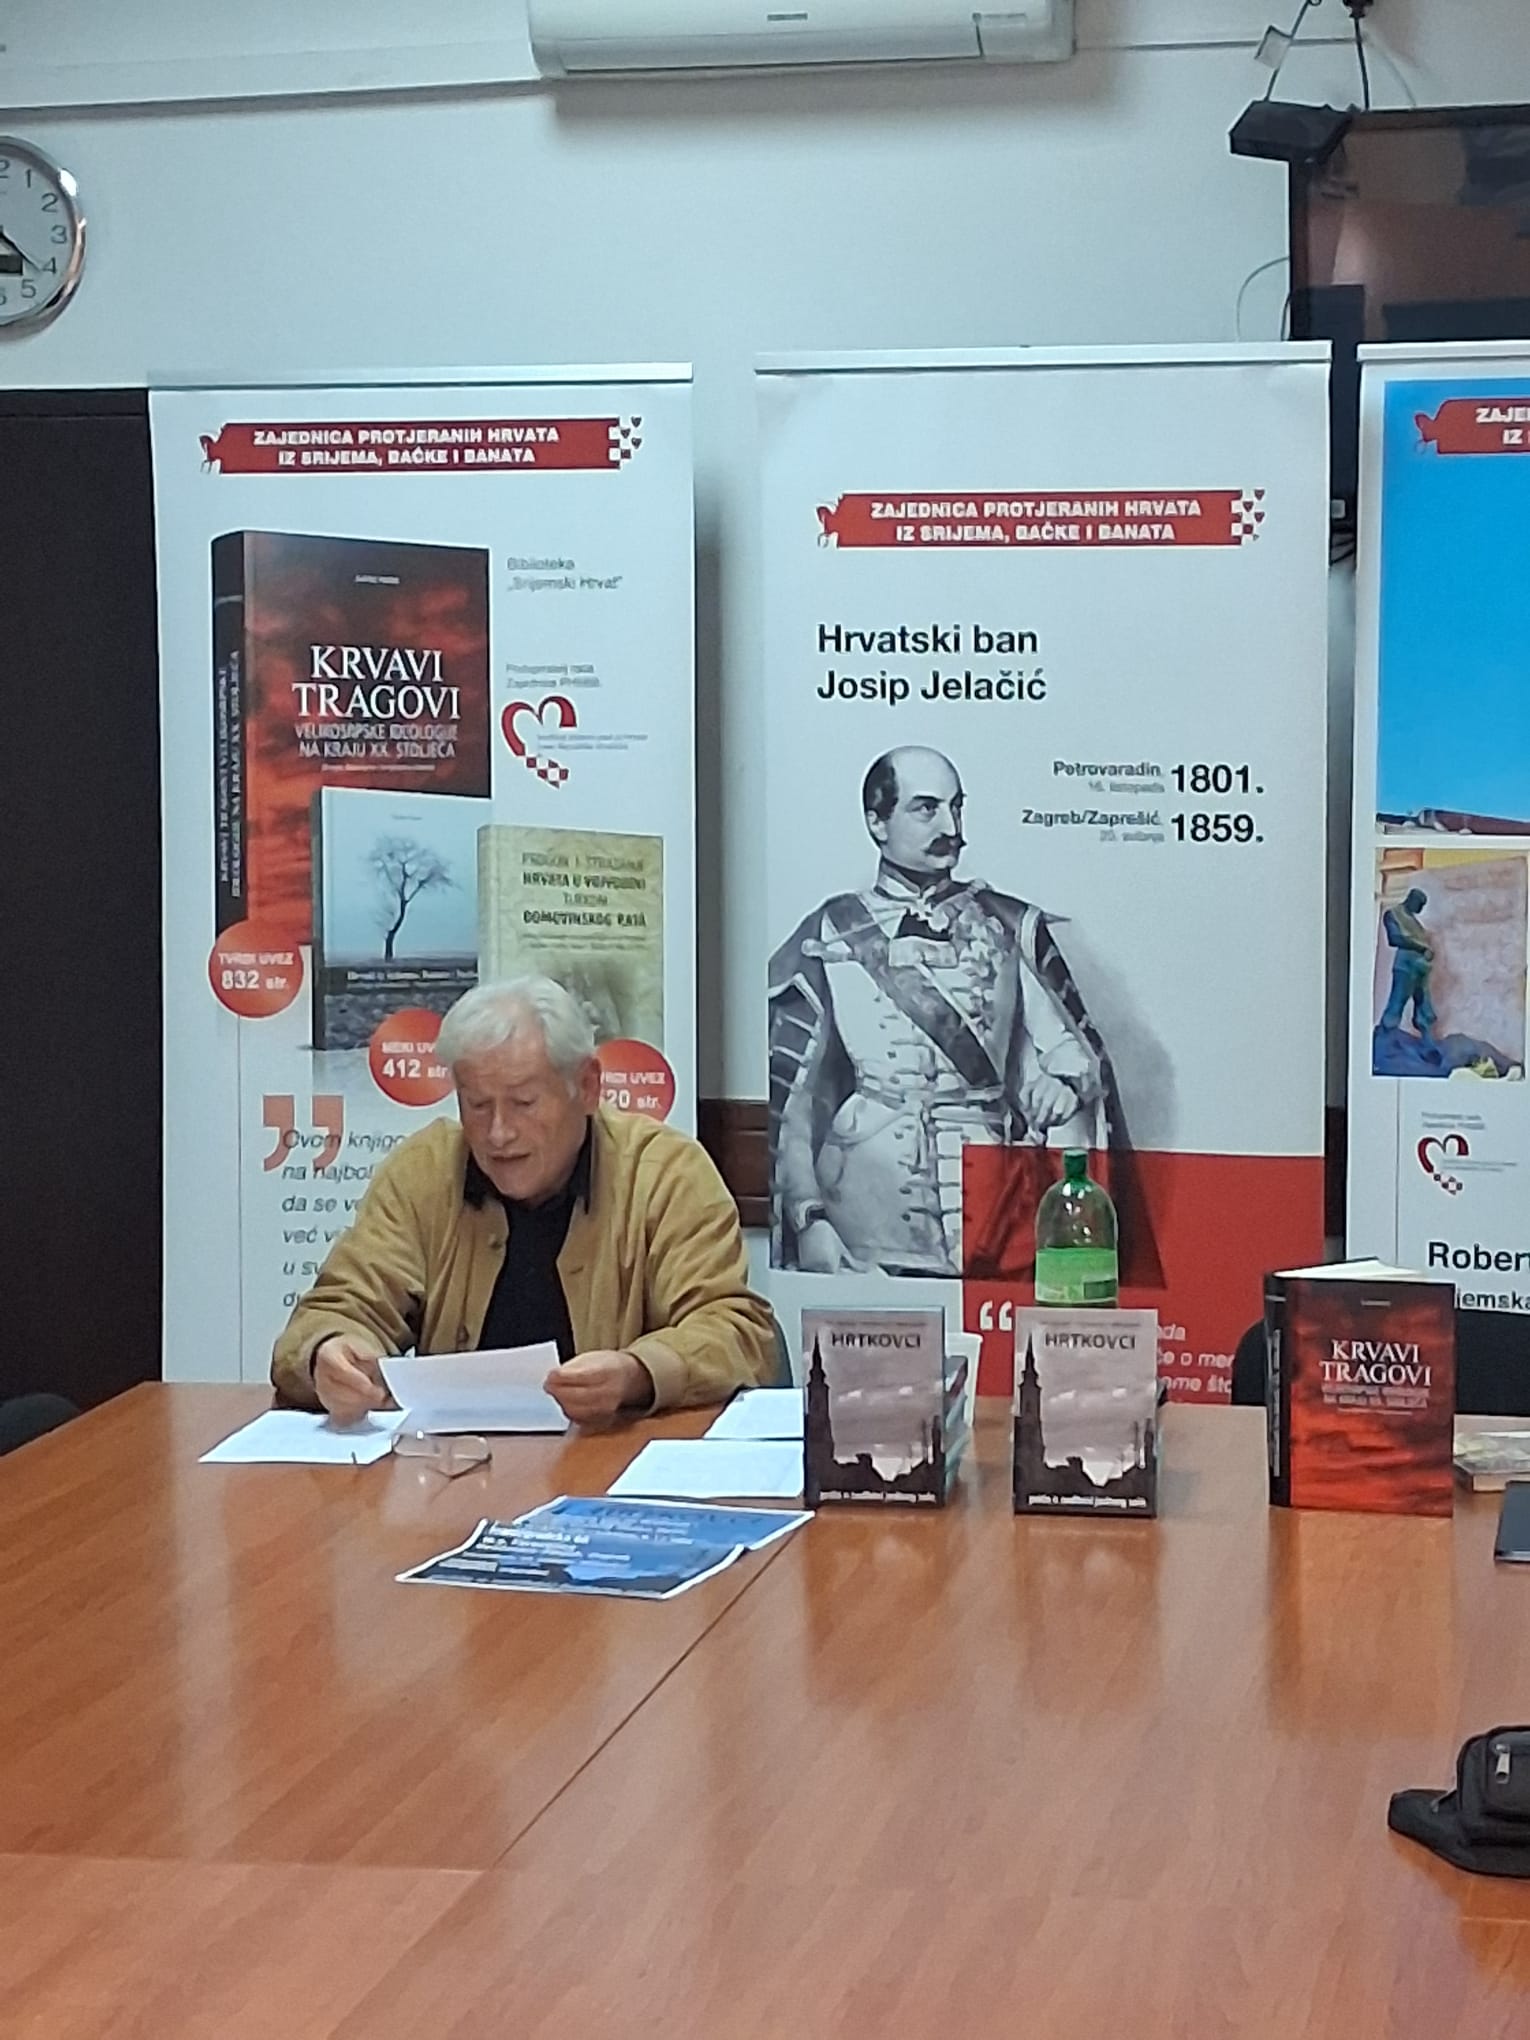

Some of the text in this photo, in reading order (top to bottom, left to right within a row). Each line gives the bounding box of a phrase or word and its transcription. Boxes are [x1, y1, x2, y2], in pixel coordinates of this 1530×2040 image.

[24, 169, 32, 188] 1
[41, 193, 58, 213] 2
[51, 225, 67, 244] 3
[42, 257, 57, 274] 4
[21, 279, 36, 298] 5
[1476, 407, 1530, 424] ZAJE
[253, 428, 559, 446] ZAJEDNICA PROTJERANIH HRVATA
[1503, 430, 1523, 445] IZ
[278, 446, 536, 467] IZ SRIJEMA, BAČKE I BANATA
[871, 499, 1202, 519] ZAJEDNICA PROTJERANIH HRVATA
[896, 522, 1176, 544] IZ SRIJEMA, BAČKE I BANATA
[818, 624, 1038, 654] Hrvatski ban
[311, 645, 443, 682] KRVAVI
[817, 668, 1047, 706] Josip Jelačić
[291, 683, 461, 719] TRAGOVI
[1053, 761, 1161, 776] Petrovaradin
[1171, 764, 1264, 793] 1801.
[1171, 813, 1264, 842] 1859.
[222, 970, 260, 990] 832
[382, 1058, 421, 1078] 412
[348, 1131, 407, 1152] knjigo
[282, 1164, 374, 1184] na najbol
[282, 1195, 307, 1212] da
[1428, 1241, 1530, 1272] Rober
[283, 1262, 296, 1275] u
[1045, 1332, 1136, 1350] HRTKOVCI
[1331, 1339, 1420, 1363] KRVAVI
[1319, 1360, 1432, 1386] TRAGOVI
